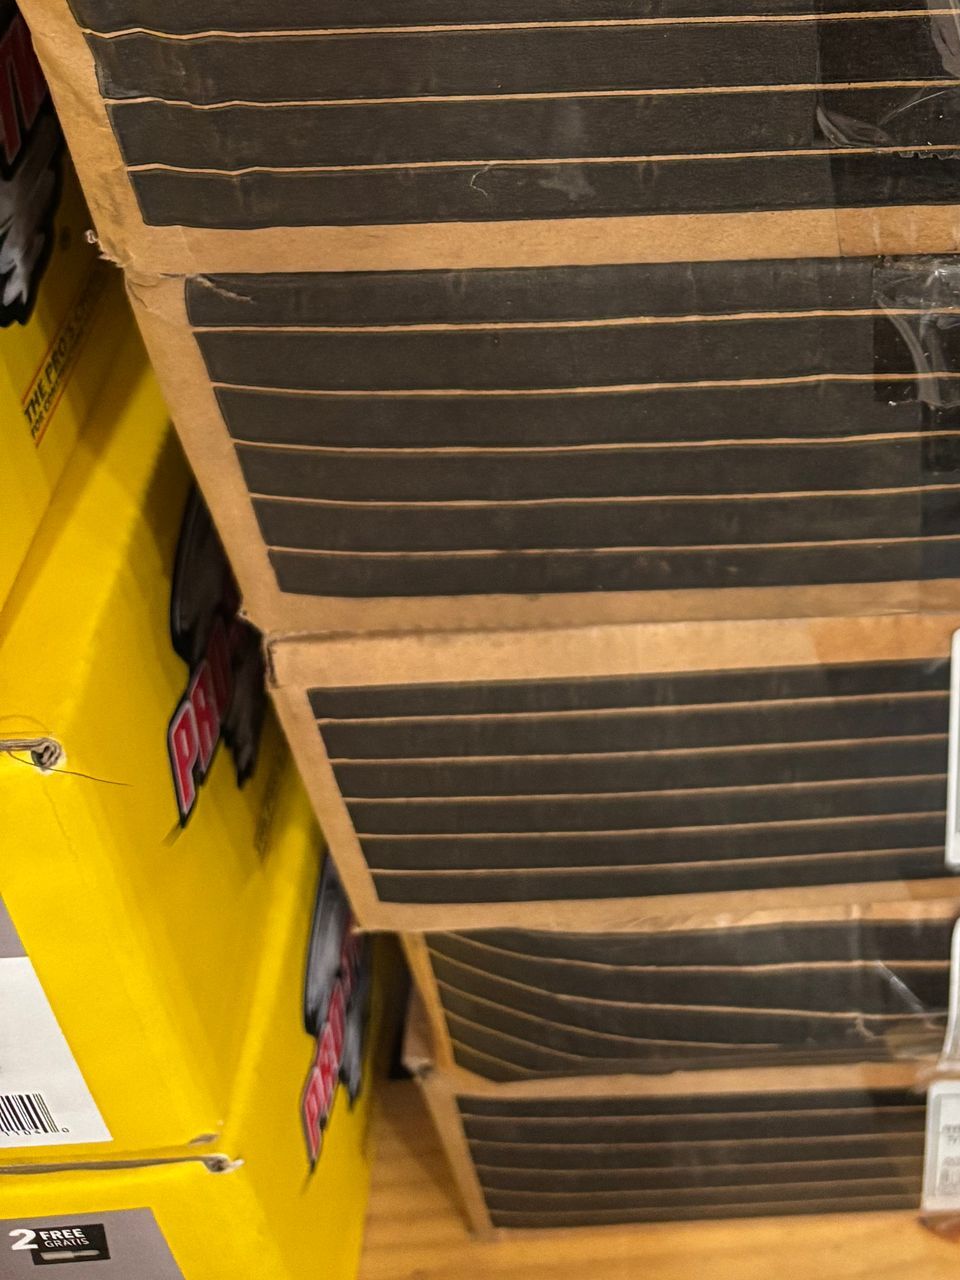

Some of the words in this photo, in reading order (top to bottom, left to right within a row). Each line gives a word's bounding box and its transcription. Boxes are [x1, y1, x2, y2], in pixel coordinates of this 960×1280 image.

[8, 1228, 39, 1251] 2
[39, 1228, 86, 1240] FREE
[44, 1238, 90, 1248] GRATIS
